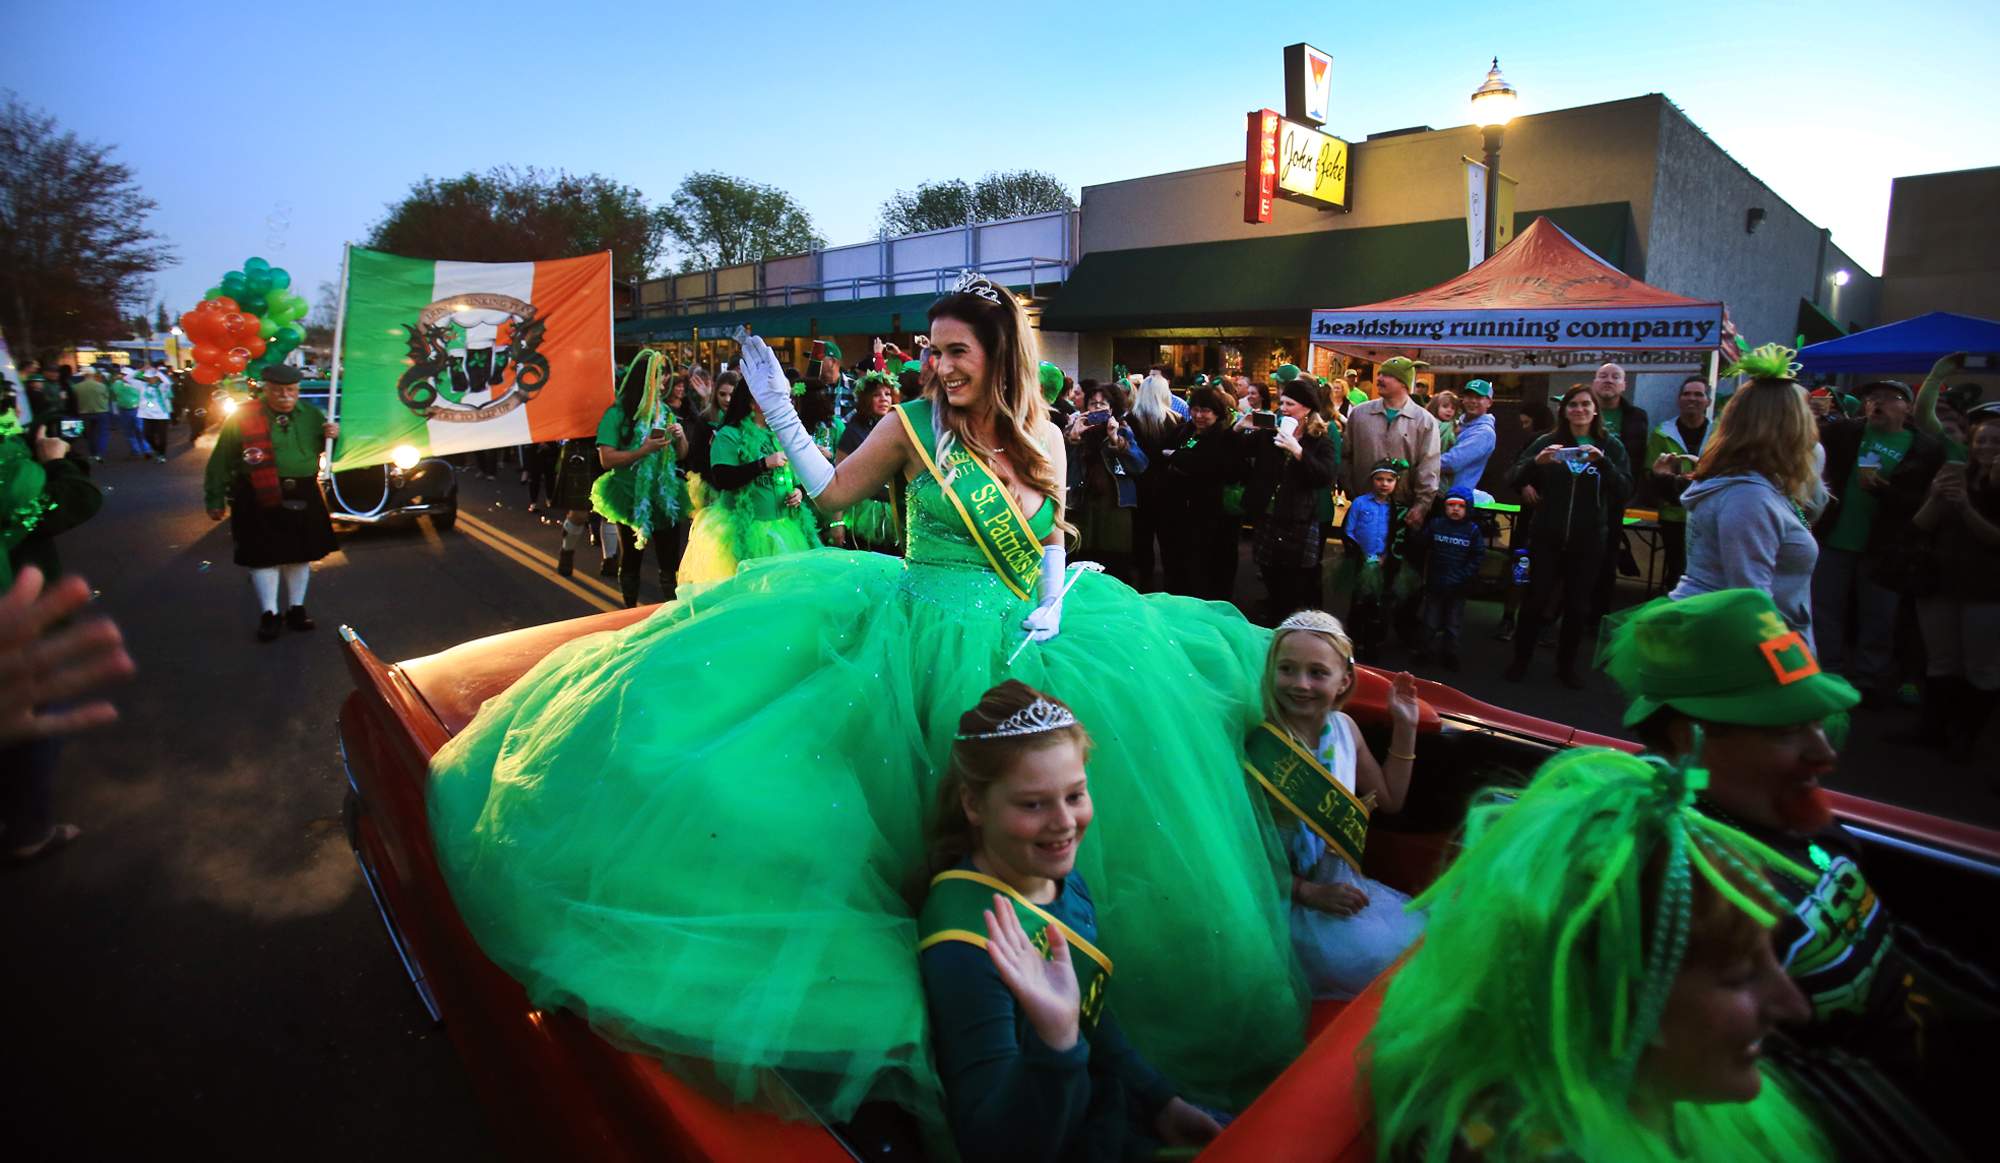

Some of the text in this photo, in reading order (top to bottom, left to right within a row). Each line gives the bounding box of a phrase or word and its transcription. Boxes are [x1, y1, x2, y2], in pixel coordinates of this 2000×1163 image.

[1281, 129, 1313, 182] John
[1315, 317, 1716, 342] healdsburg running company
[952, 461, 976, 480] 017
[970, 483, 998, 515] St.
